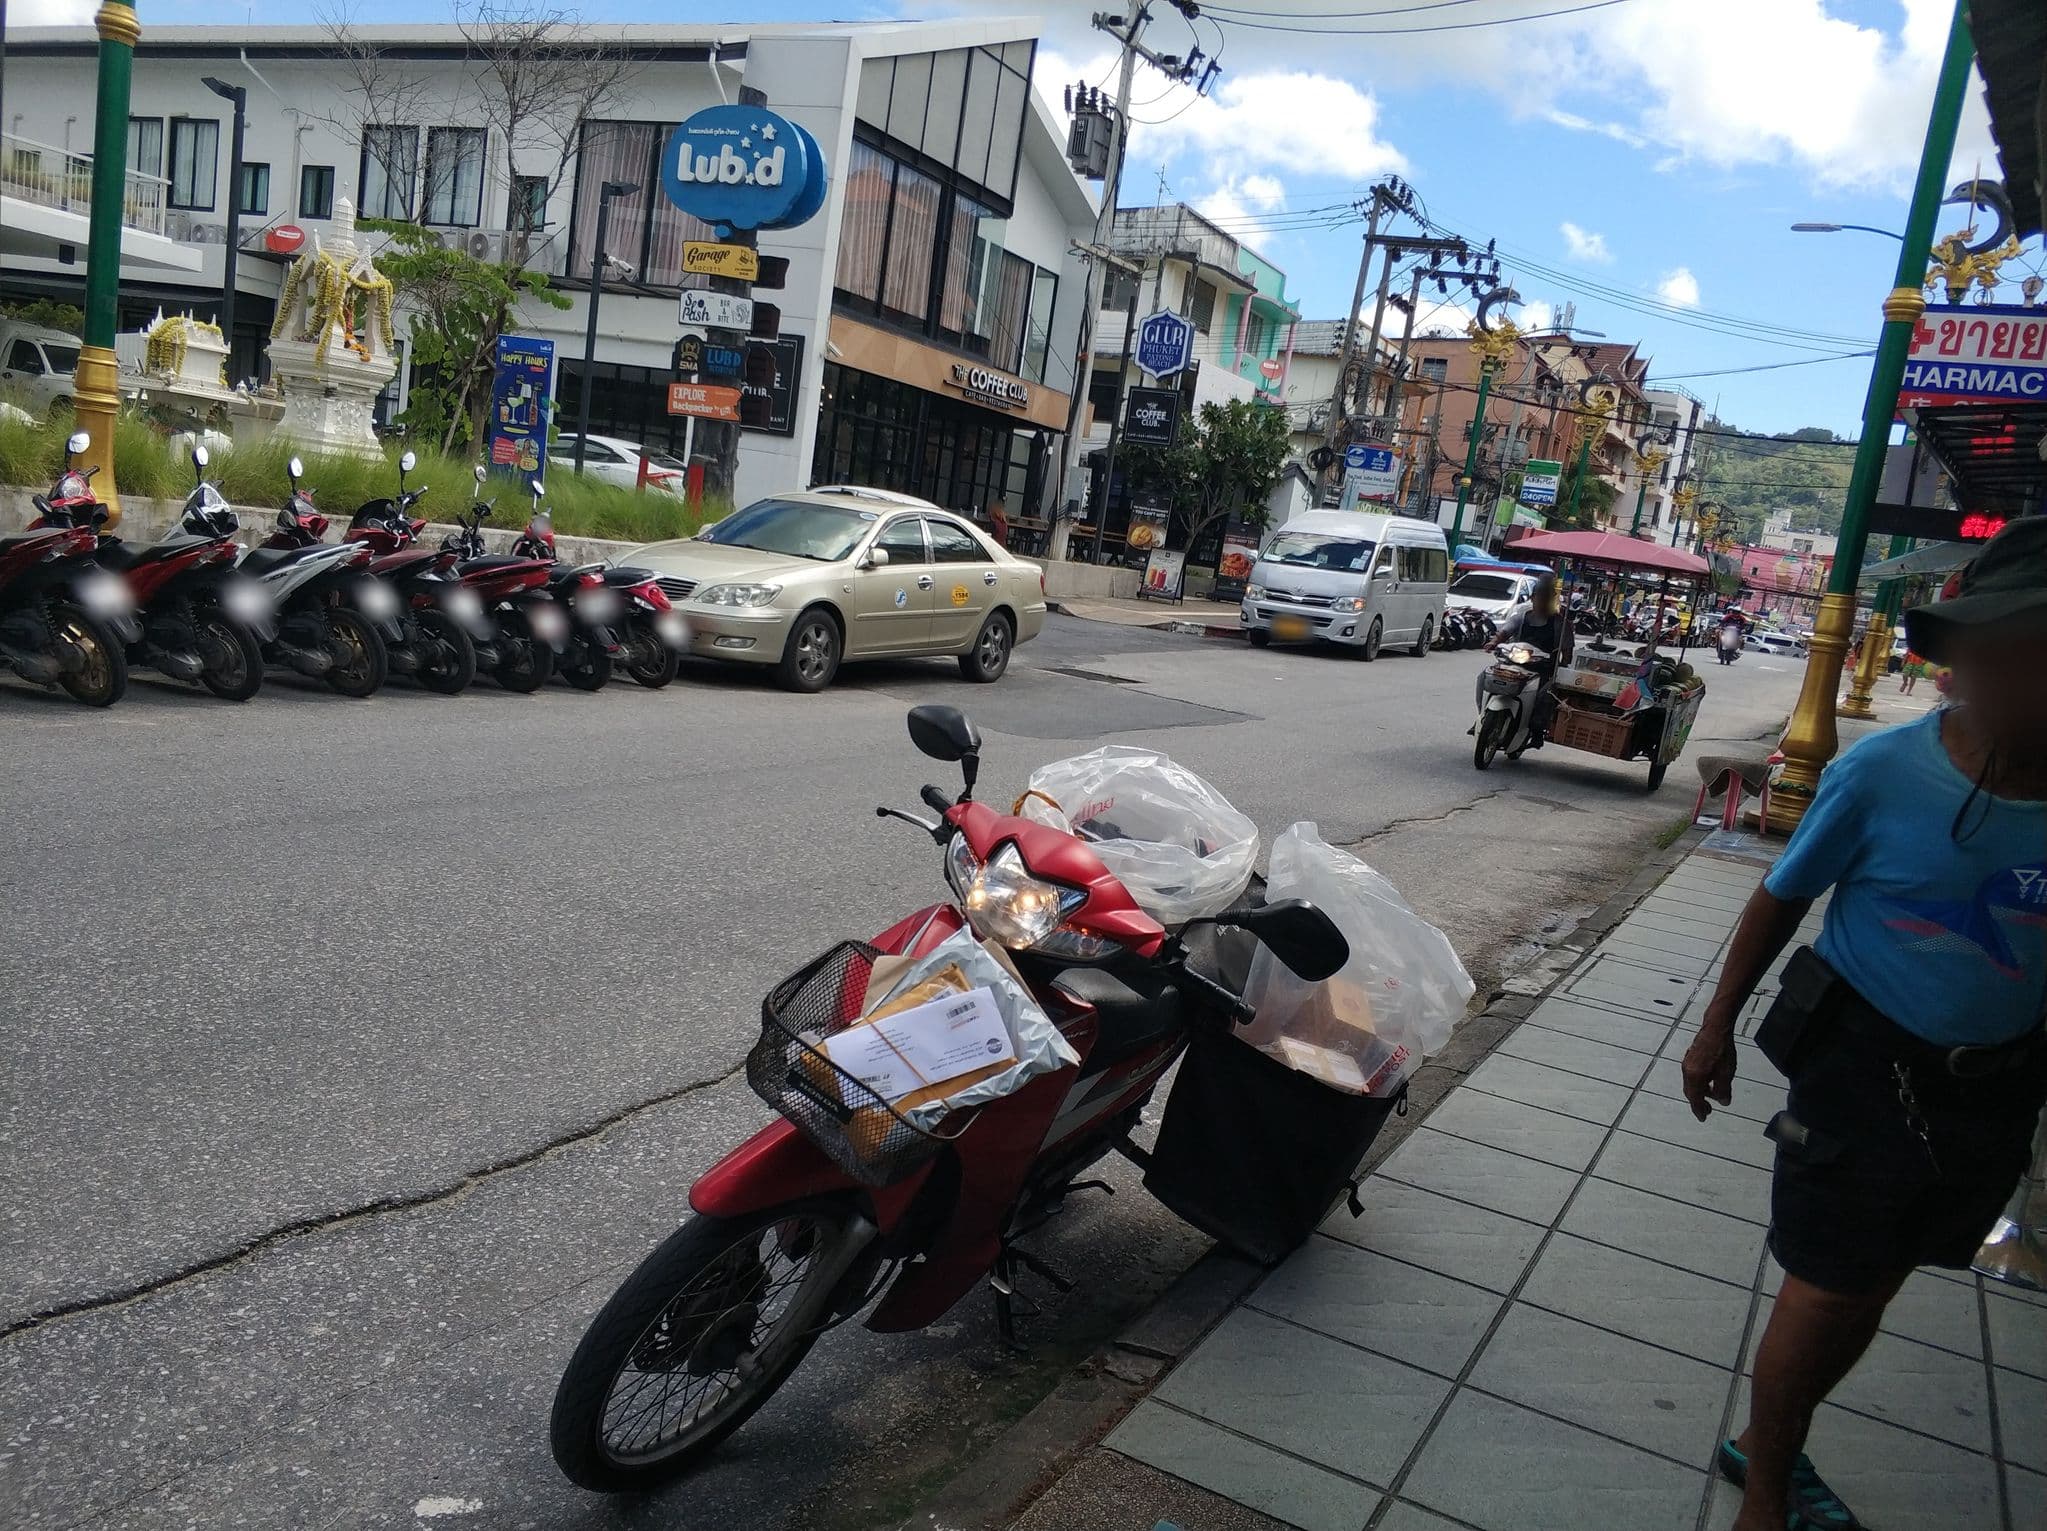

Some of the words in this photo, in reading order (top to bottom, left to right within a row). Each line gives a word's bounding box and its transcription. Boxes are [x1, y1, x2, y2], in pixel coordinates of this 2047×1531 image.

[687, 247, 731, 265] Garage
[1143, 344, 1181, 356] PHUKET
[970, 367, 1009, 397] COFFEE
[673, 387, 707, 402] EXPLORE
[1135, 408, 1167, 421] COFFEE
